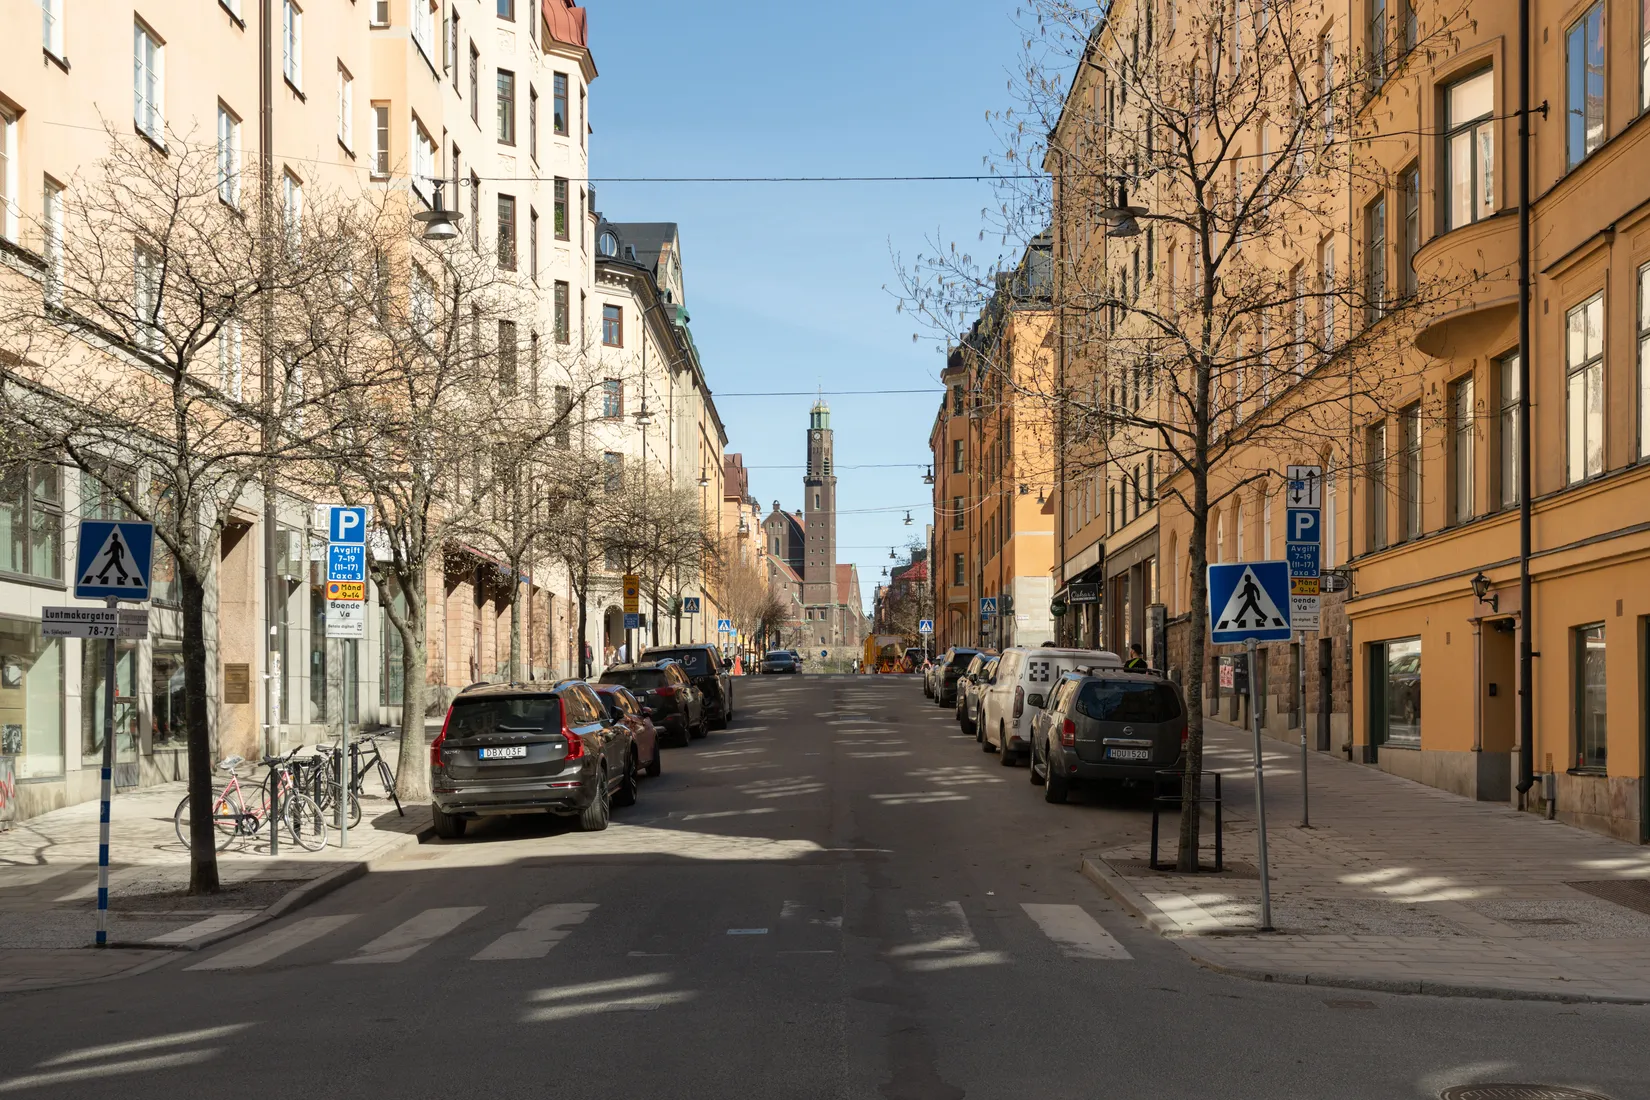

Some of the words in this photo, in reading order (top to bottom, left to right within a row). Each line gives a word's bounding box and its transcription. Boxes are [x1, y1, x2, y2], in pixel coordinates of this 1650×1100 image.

[338, 510, 360, 539] P
[1296, 512, 1314, 539] P
[334, 546, 360, 554] Avgift
[334, 563, 358, 571] (11-17)
[45, 609, 115, 622] Luntmakargatan
[88, 626, 114, 636] 78-72
[506, 748, 522, 756] 03F
